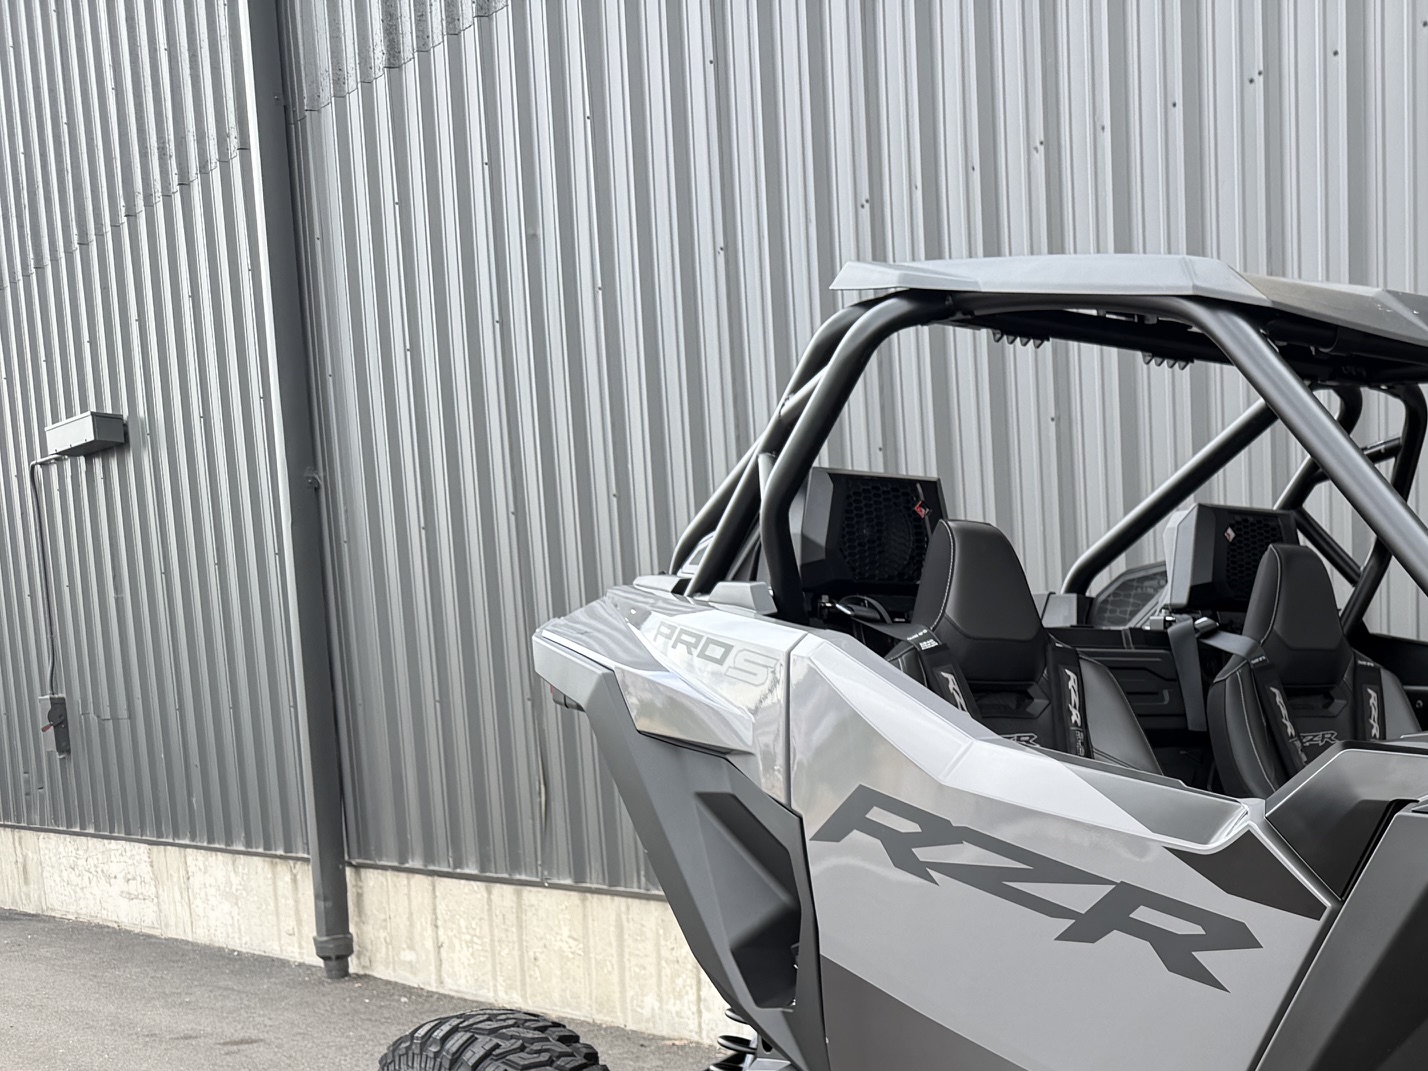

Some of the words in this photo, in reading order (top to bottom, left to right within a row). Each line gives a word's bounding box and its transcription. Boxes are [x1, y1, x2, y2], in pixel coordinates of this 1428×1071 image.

[653, 621, 734, 666] PRO
[941, 671, 969, 716] RZ
[1065, 668, 1083, 727] RZR
[1270, 686, 1296, 738] RZR
[1367, 687, 1380, 739] RZR
[1300, 730, 1340, 747] ZR
[809, 784, 1264, 993] RZR
